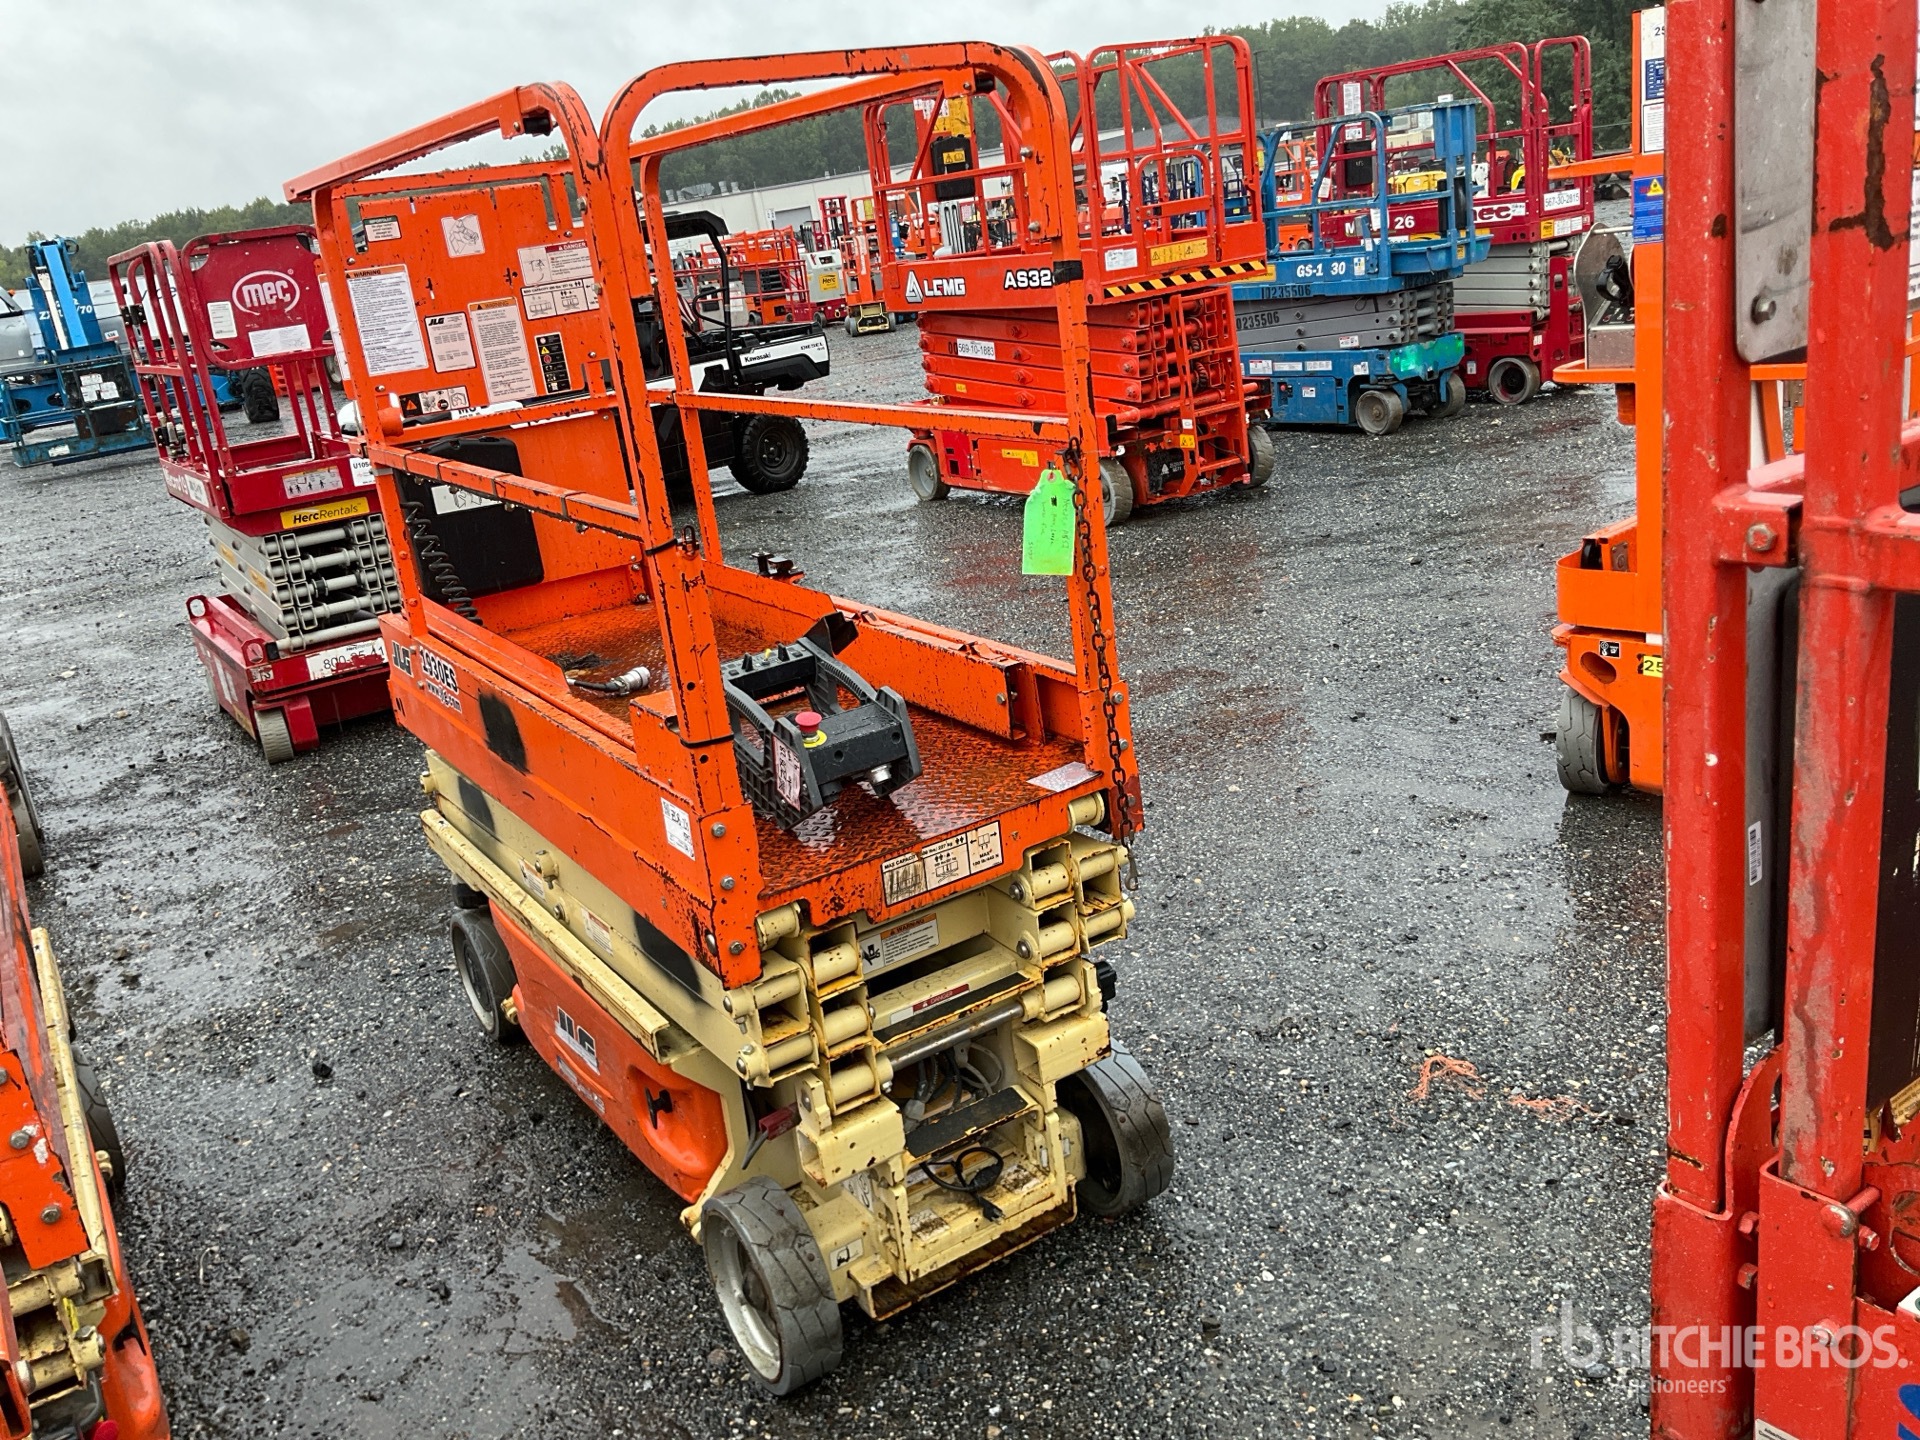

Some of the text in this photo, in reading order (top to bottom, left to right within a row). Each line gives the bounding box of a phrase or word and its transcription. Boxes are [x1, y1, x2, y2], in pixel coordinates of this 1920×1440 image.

[1545, 193, 1580, 208] 567-30-2815
[1394, 215, 1415, 230] 26
[353, 269, 381, 278] WARNING
[1003, 268, 1055, 290] AS32
[241, 279, 292, 309] mec
[428, 317, 445, 326] JLG
[958, 342, 995, 357] 569-10-1883
[744, 352, 771, 363] Kawasaki
[392, 640, 459, 694] JLG 1930ES
[884, 862, 895, 870] MAX
[896, 919, 926, 932] WARNING
